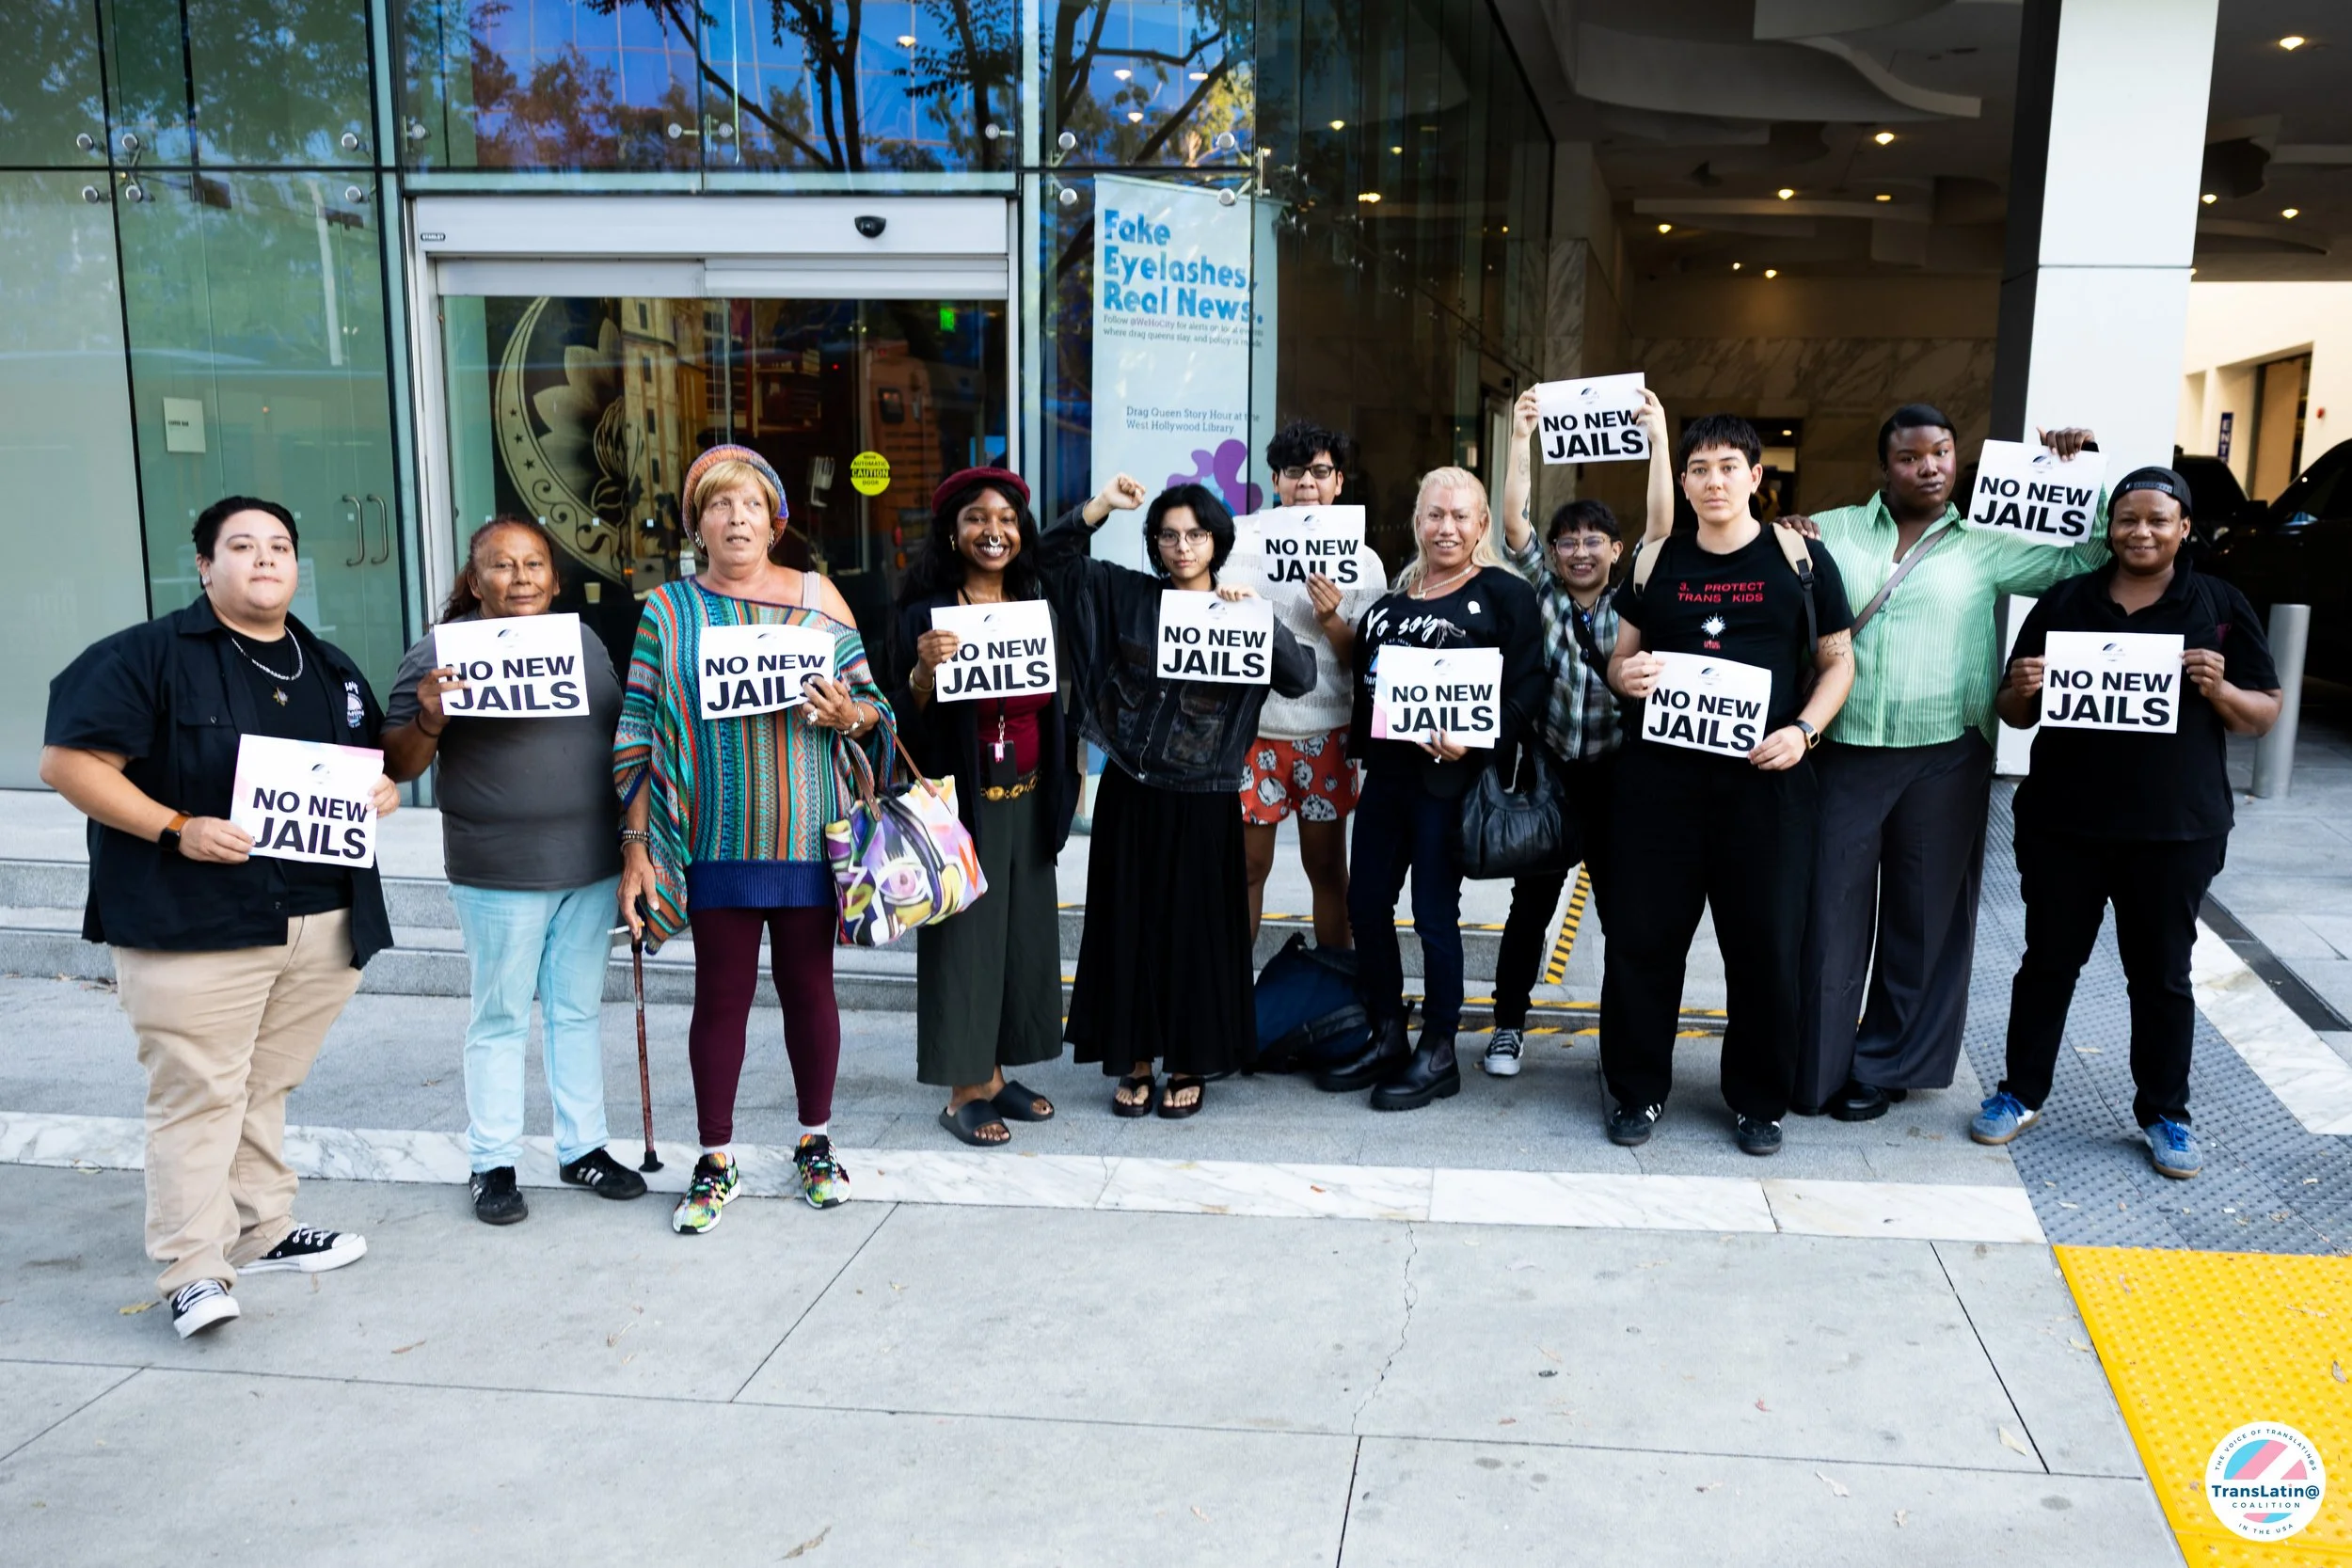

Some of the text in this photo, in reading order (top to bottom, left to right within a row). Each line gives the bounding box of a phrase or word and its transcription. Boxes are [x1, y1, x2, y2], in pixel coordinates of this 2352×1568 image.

[1104, 209, 1170, 245] Fake
[1104, 280, 1263, 325] Real News.
[1104, 314, 1128, 325] Follow
[1130, 317, 1174, 329] @WeHoCity
[1104, 327, 1126, 337] where
[1129, 329, 1146, 340] drag
[1148, 332, 1174, 341] queens
[1127, 405, 1149, 418] Drag
[1151, 407, 1182, 418] Queen
[1184, 408, 1207, 420] Story
[1210, 409, 1232, 420] Hour
[1234, 412, 1242, 420] at
[1543, 409, 1639, 432] NO NEW
[1126, 419, 1234, 435] West Hollywood Library
[1548, 429, 1644, 459] JAILS
[851, 468, 888, 478] CAUTION
[1979, 476, 2093, 507] NO NEW
[1974, 499, 2087, 537] JAILS
[1265, 539, 1359, 556] NO NEW
[1678, 593, 1763, 603] TRANS KIDS
[1679, 581, 1765, 592] 3. PROTECT
[1164, 626, 1266, 648] NO NEW
[1365, 608, 1438, 643] Yo soy
[987, 638, 1046, 659] NEW
[445, 655, 575, 681] NO NEW
[706, 654, 826, 676] NO NEW
[1163, 648, 1264, 677] JAILS
[943, 660, 1050, 694] JAILS
[2050, 669, 2173, 692] NO NEW
[449, 681, 580, 711] JAILS
[1392, 684, 1493, 703] NO NEW
[1651, 688, 1761, 721] NO NEW
[1391, 706, 1494, 733] JAILS
[2047, 693, 2170, 726] JAILS
[1648, 711, 1756, 752] JAILS
[252, 787, 369, 823] NO NEW
[252, 816, 366, 859] JAILS
